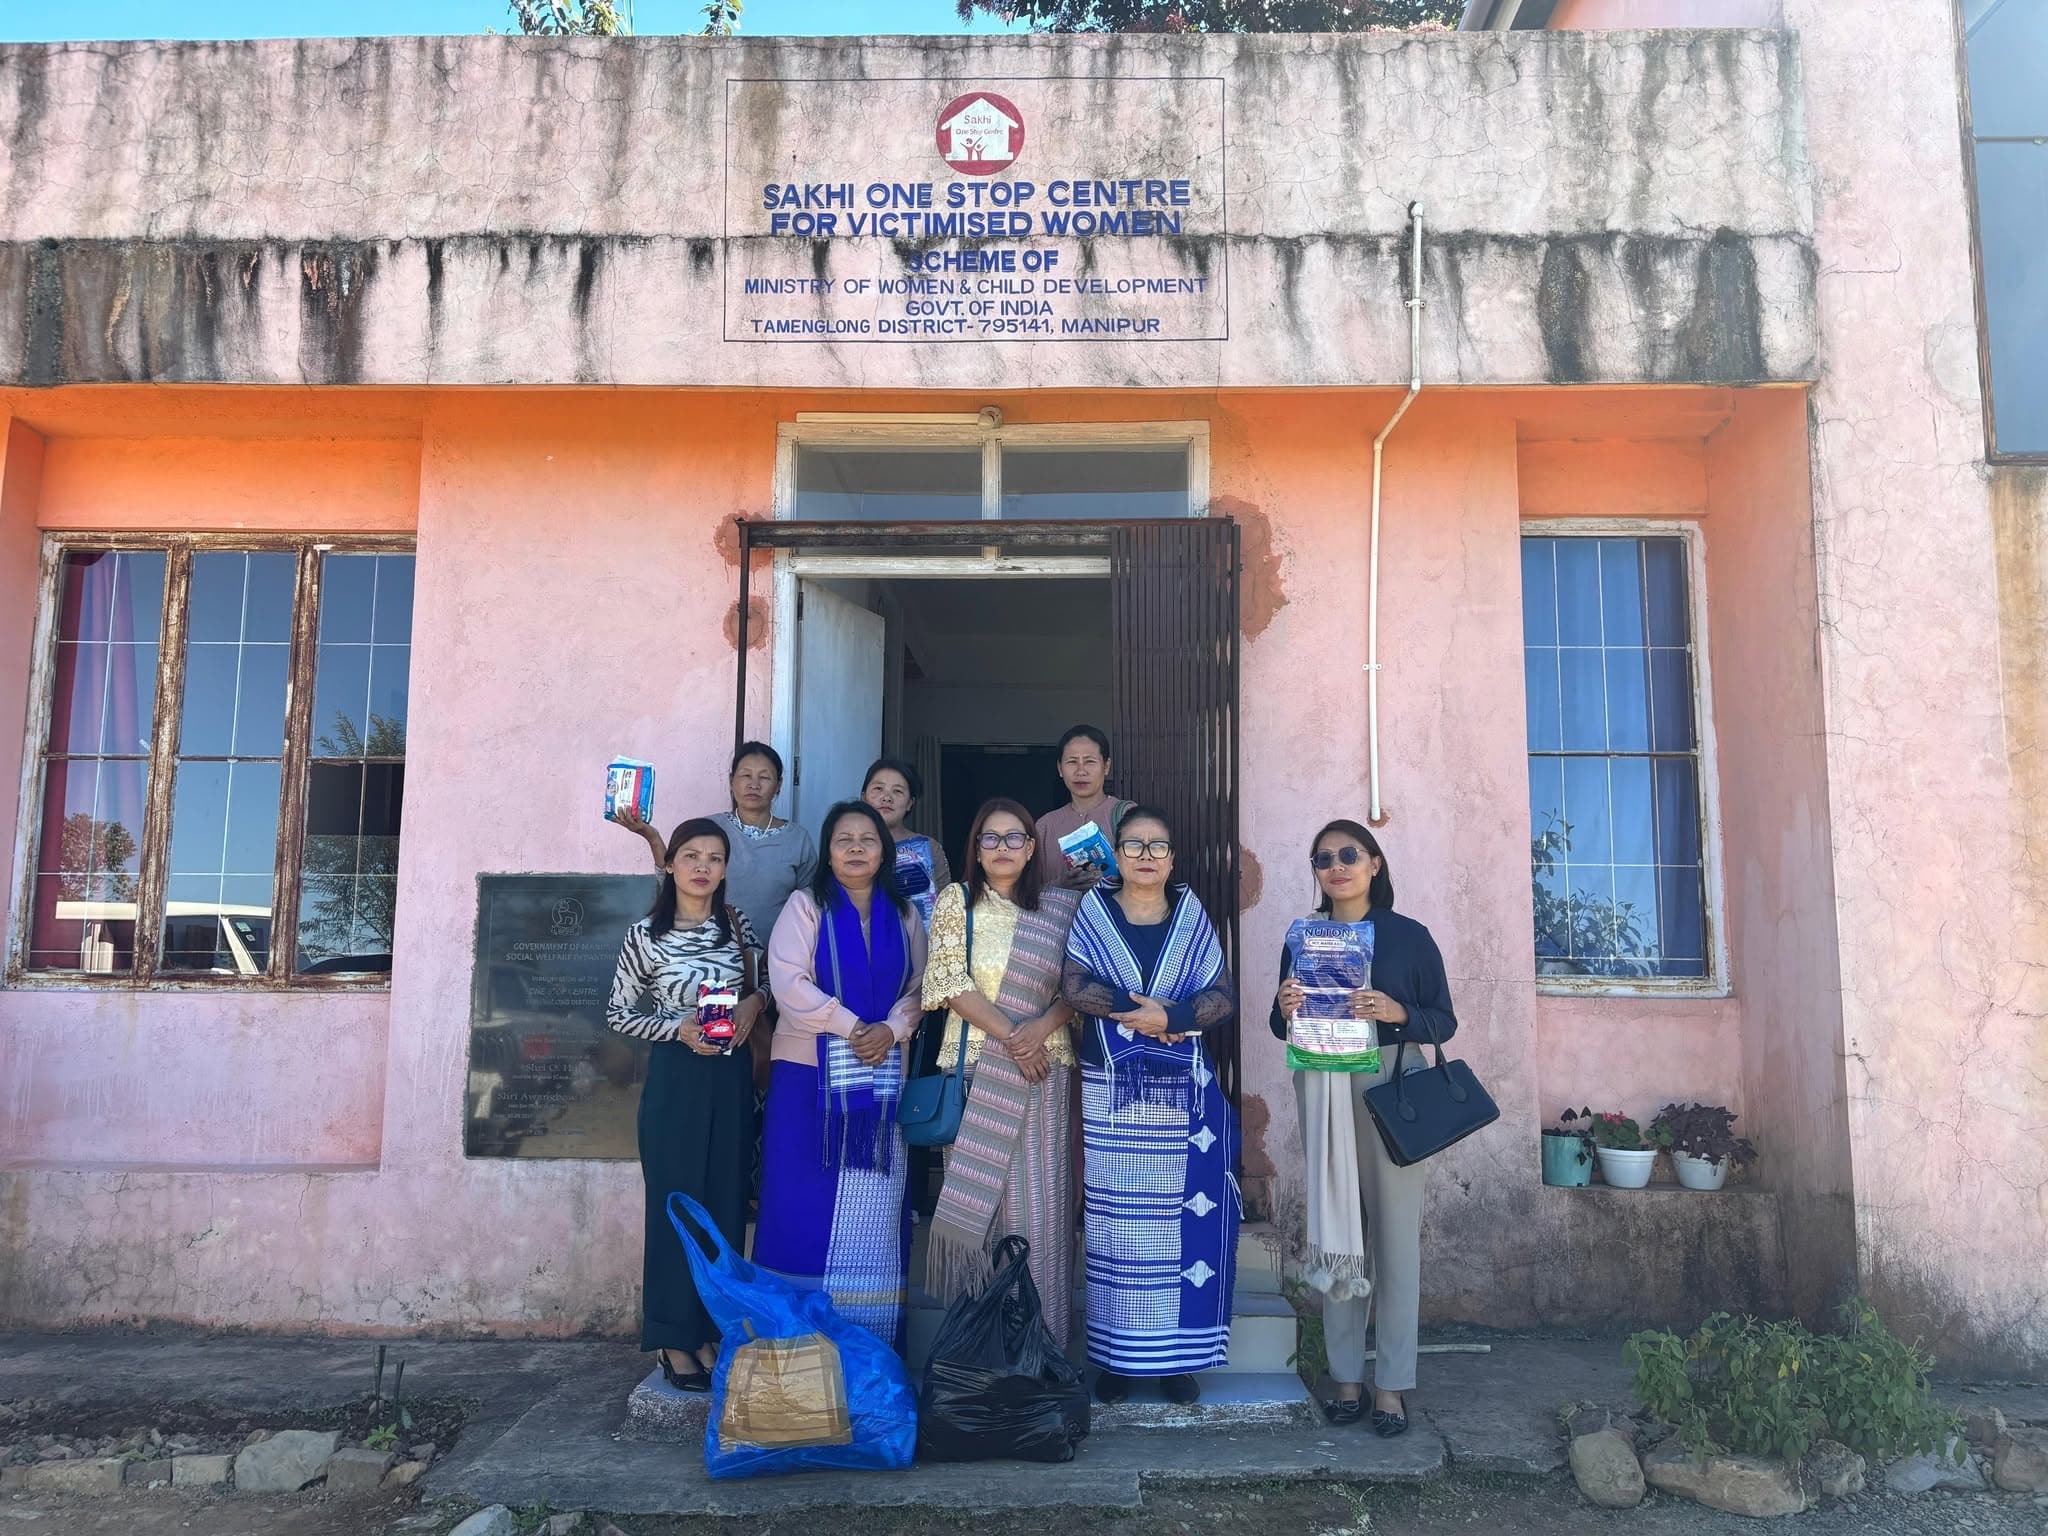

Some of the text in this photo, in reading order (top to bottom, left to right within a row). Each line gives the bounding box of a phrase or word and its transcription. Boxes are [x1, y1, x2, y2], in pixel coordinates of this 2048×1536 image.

[963, 114, 992, 125] Sakhi
[763, 179, 1190, 210] SAKHI ONE STOP CENTRE
[770, 210, 1182, 238] FOR VICTIMISED WOMEN
[909, 249, 1059, 273] SCHEME OF
[744, 277, 1208, 295] MINISTRY OF WOMEN & CHILD DEVELOPMENT
[905, 300, 1054, 317] GOVT. OF INDIA
[750, 319, 871, 334] TAMENGLONG
[978, 318, 1055, 335] 795141,
[1061, 318, 1161, 334] MANIPUR
[513, 942, 569, 951] GOVERNMENT
[505, 952, 534, 961] SOCIAL
